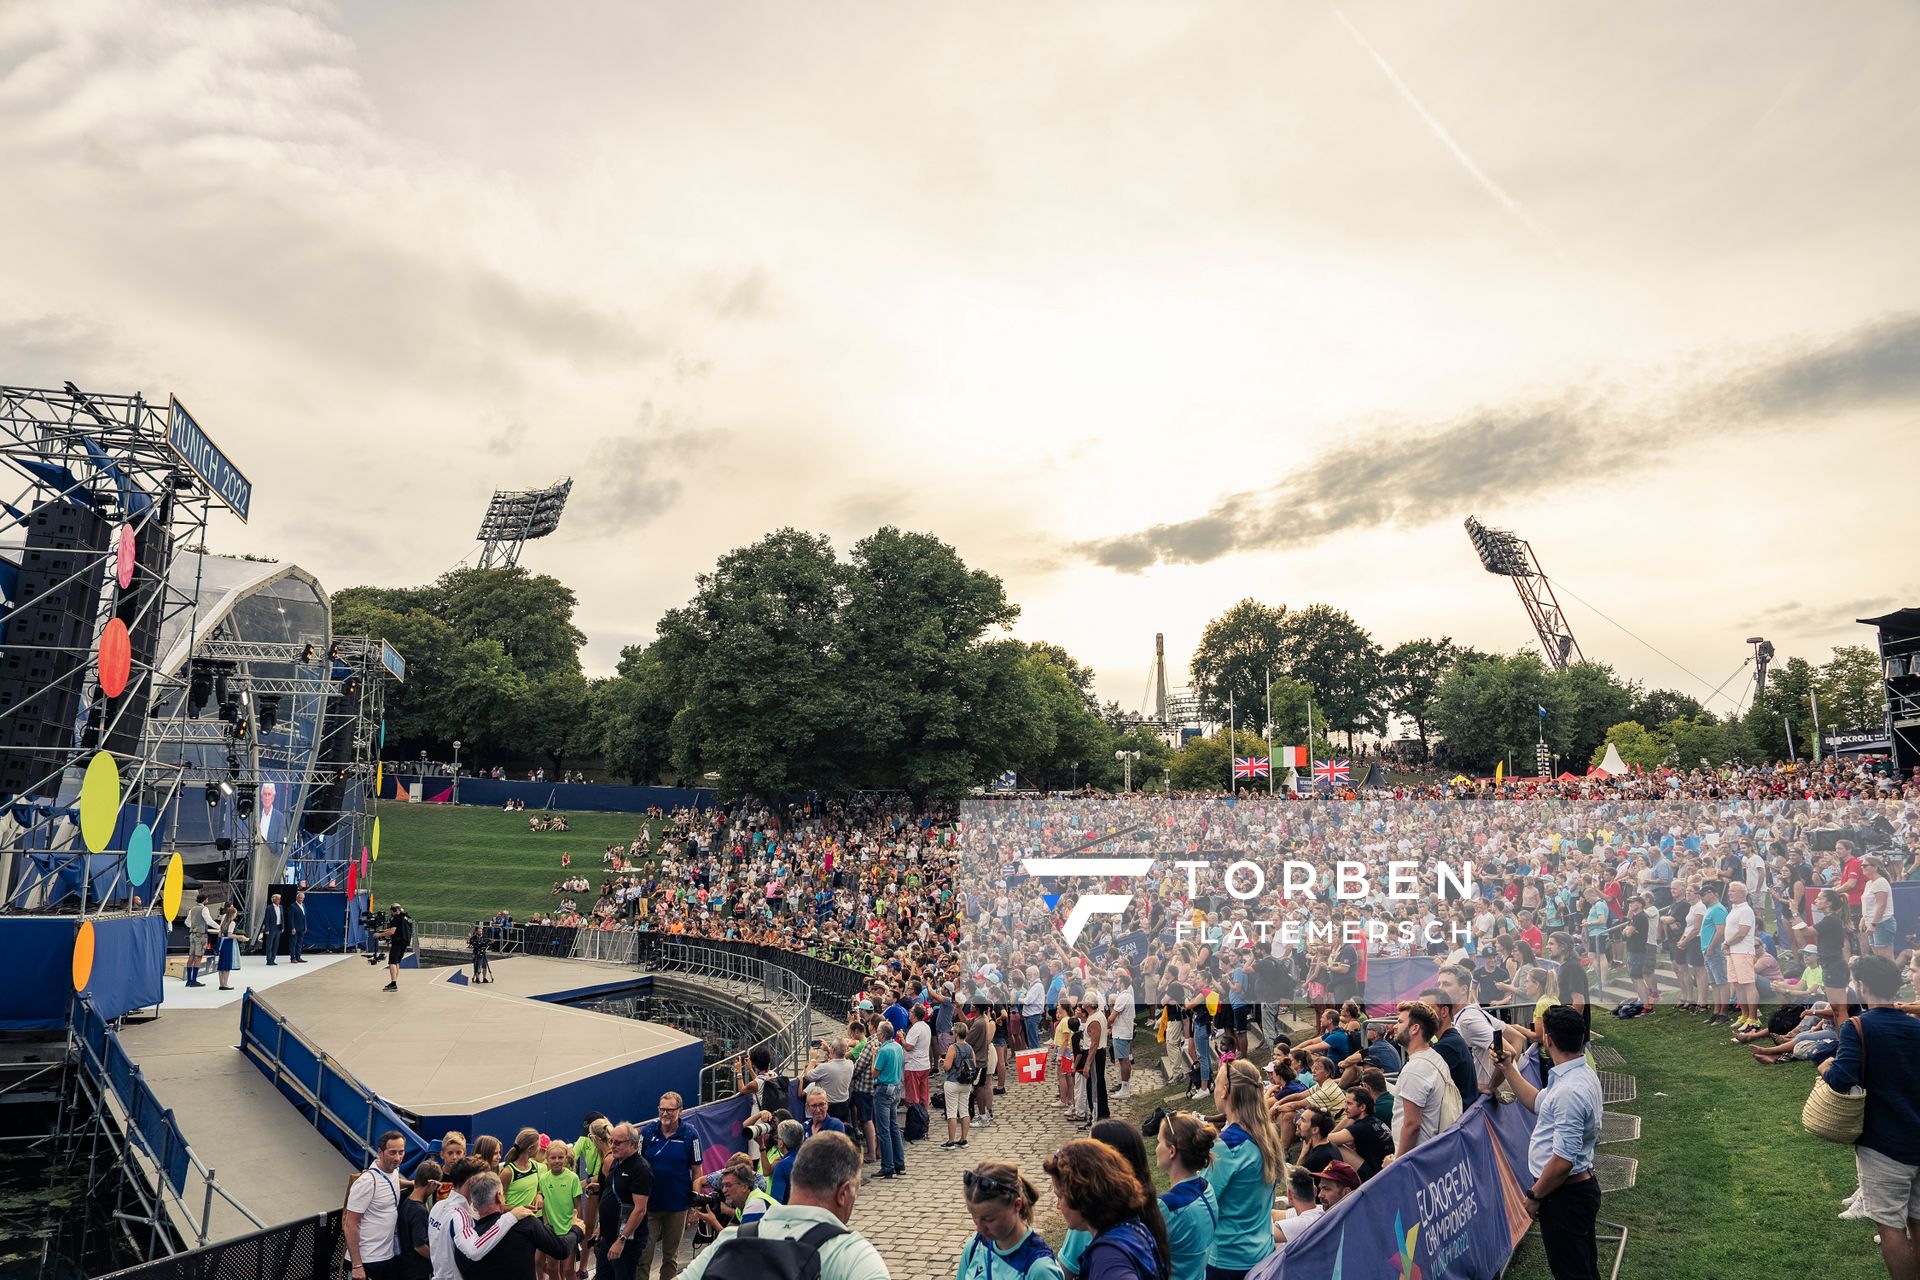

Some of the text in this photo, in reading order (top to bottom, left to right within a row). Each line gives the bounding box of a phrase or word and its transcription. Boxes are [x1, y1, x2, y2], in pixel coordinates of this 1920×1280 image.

[170, 405, 248, 513] MUNICH 2022
[1825, 734, 1873, 744] BCKROLL
[1095, 941, 1137, 964] EUEAN
[1416, 1156, 1474, 1228] EUROPEAN
[1425, 1192, 1478, 1256] CHAMPIONSHIPS
[1453, 1231, 1470, 1259] 2022
